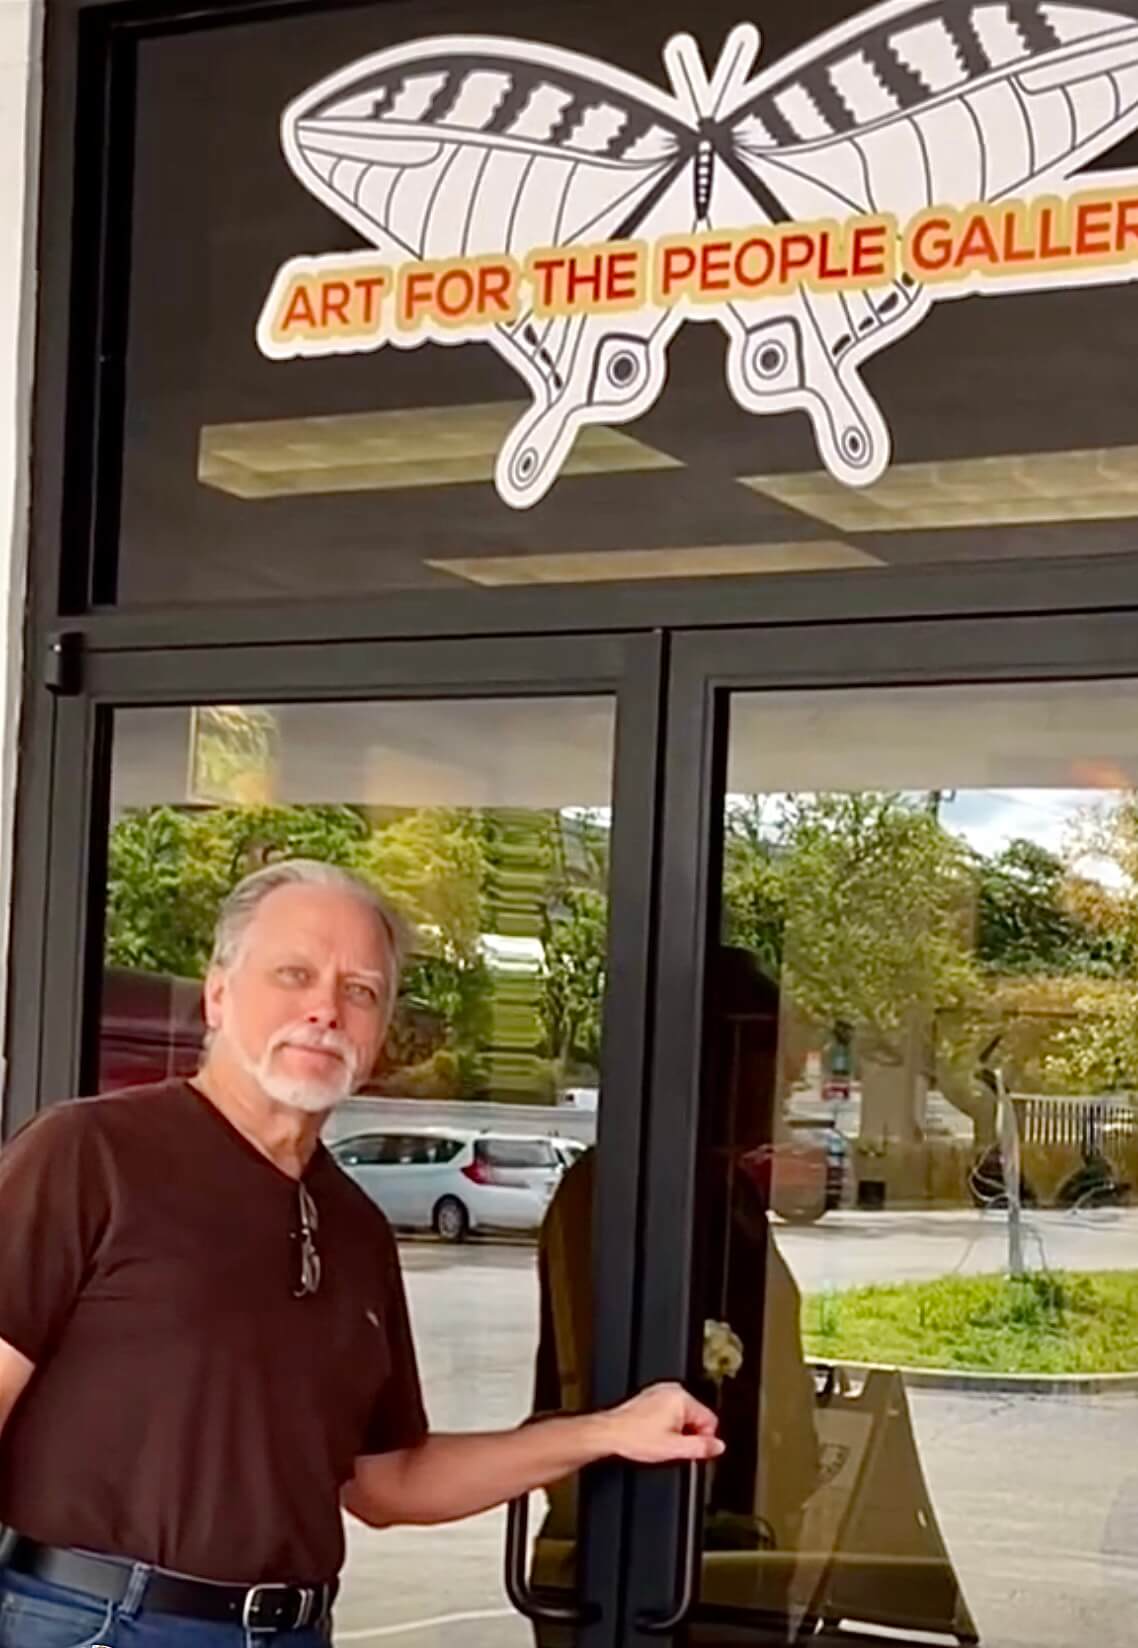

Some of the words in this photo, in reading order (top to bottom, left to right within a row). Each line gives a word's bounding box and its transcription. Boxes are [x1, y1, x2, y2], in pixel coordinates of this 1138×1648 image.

[281, 277, 385, 331] ART
[405, 266, 511, 320] FOR
[534, 252, 638, 308] THE
[661, 226, 887, 294] PEOPLE
